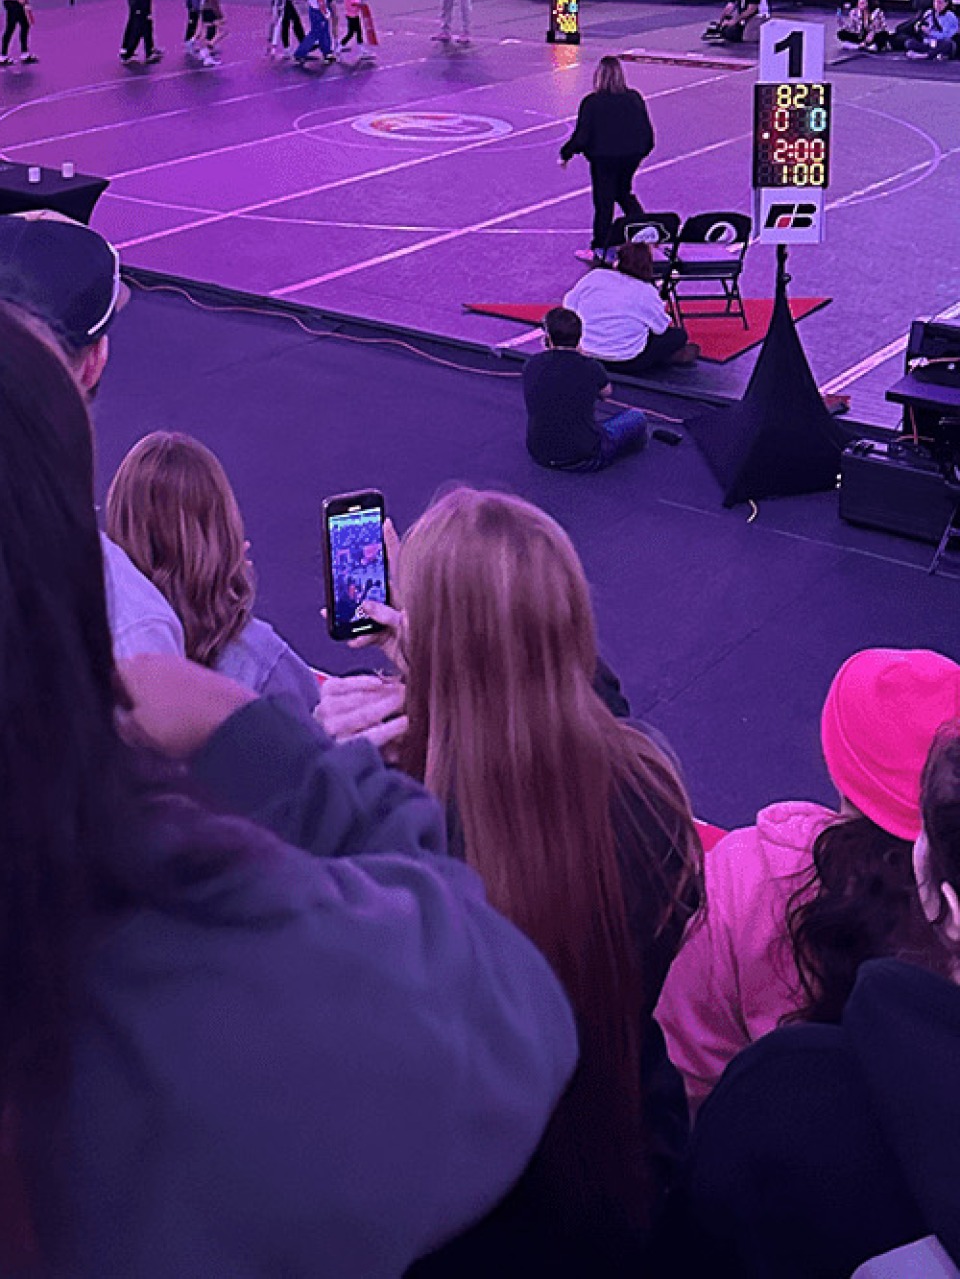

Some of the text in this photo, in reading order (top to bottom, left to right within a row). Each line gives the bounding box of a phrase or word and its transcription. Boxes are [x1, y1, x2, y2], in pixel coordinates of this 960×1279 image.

[774, 31, 804, 77] 1
[777, 84, 825, 108] 827
[775, 107, 826, 131] 0 0
[773, 138, 825, 163] 2:00
